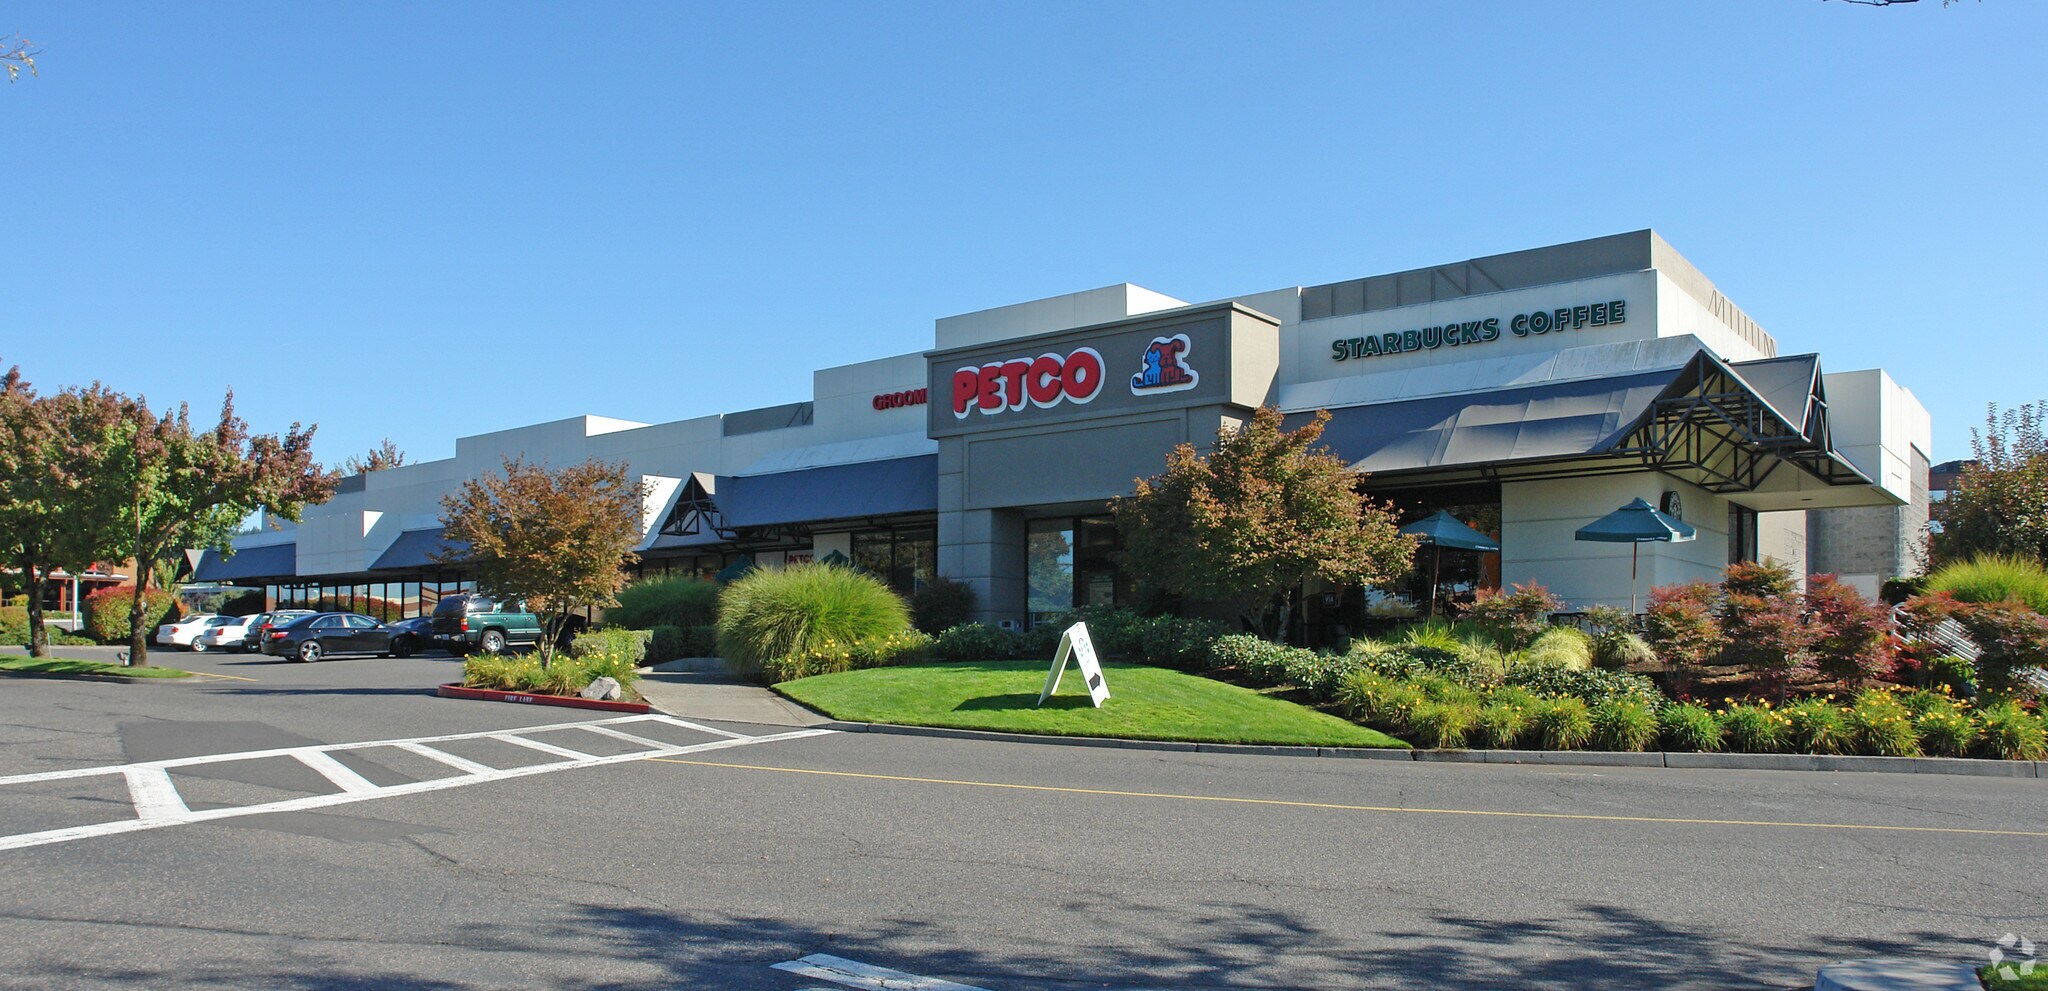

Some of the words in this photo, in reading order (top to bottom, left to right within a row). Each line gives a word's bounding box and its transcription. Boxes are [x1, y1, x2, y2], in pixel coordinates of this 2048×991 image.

[1331, 317, 1500, 361] STARBUCKS
[1510, 299, 1626, 337] COFFEE
[952, 347, 1106, 419] PETCO
